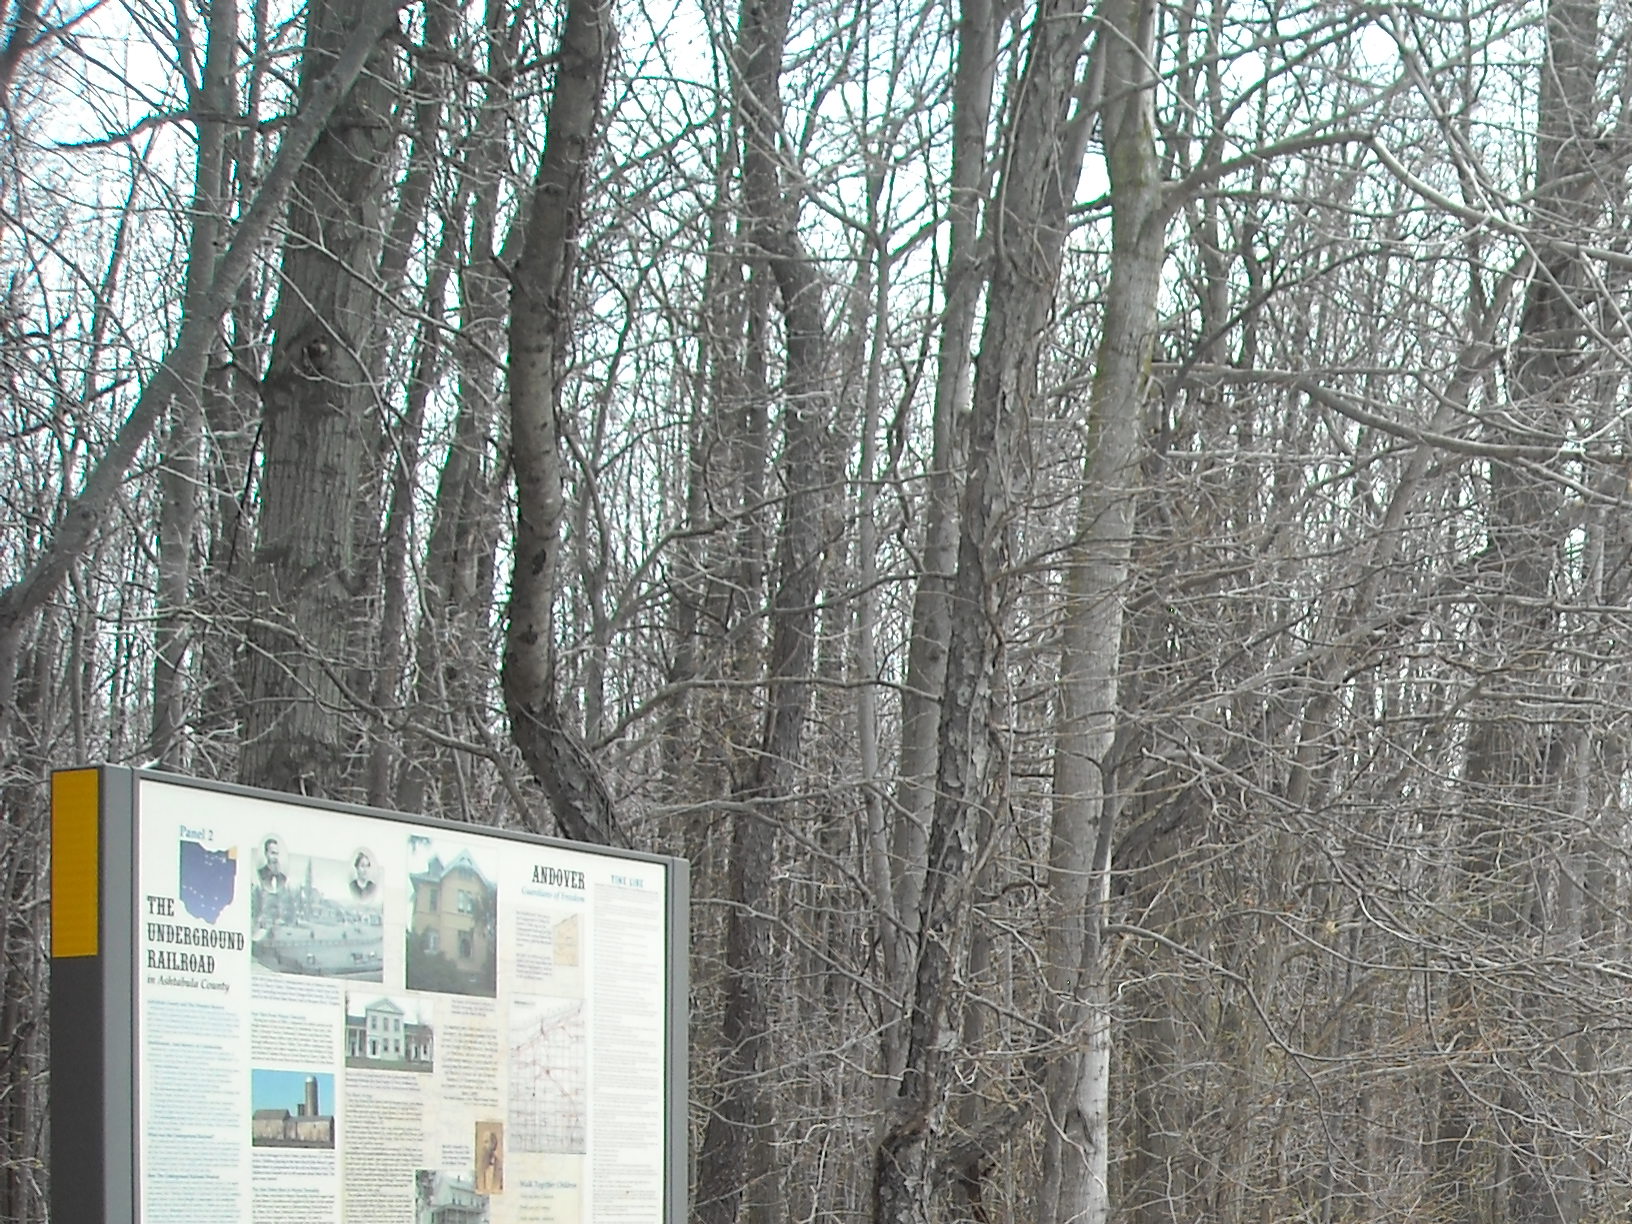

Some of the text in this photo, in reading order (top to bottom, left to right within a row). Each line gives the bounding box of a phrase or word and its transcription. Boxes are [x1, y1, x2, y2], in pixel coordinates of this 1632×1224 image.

[179, 825, 214, 841] Panel 2
[532, 865, 585, 890] ANDOVER
[147, 895, 175, 917] THE
[147, 922, 245, 951] UNDERGROUND
[147, 949, 215, 974] RAILROAD
[157, 975, 199, 989] Ashtabula
[201, 977, 230, 992] County
